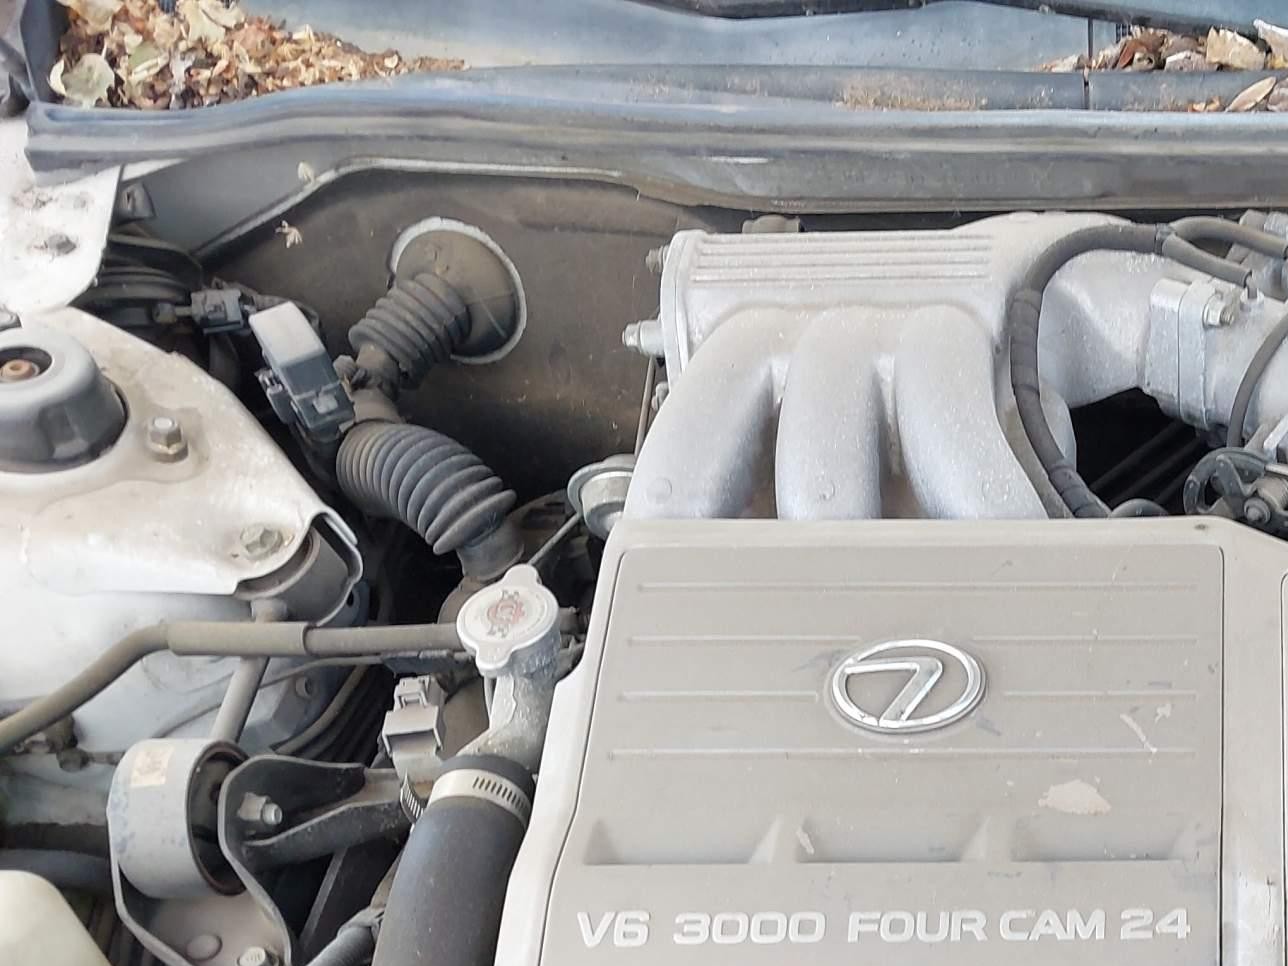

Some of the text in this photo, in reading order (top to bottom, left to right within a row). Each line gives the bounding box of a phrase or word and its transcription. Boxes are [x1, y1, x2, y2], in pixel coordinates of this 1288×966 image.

[576, 907, 1191, 947] V6 3000 FOUR CAM 24
